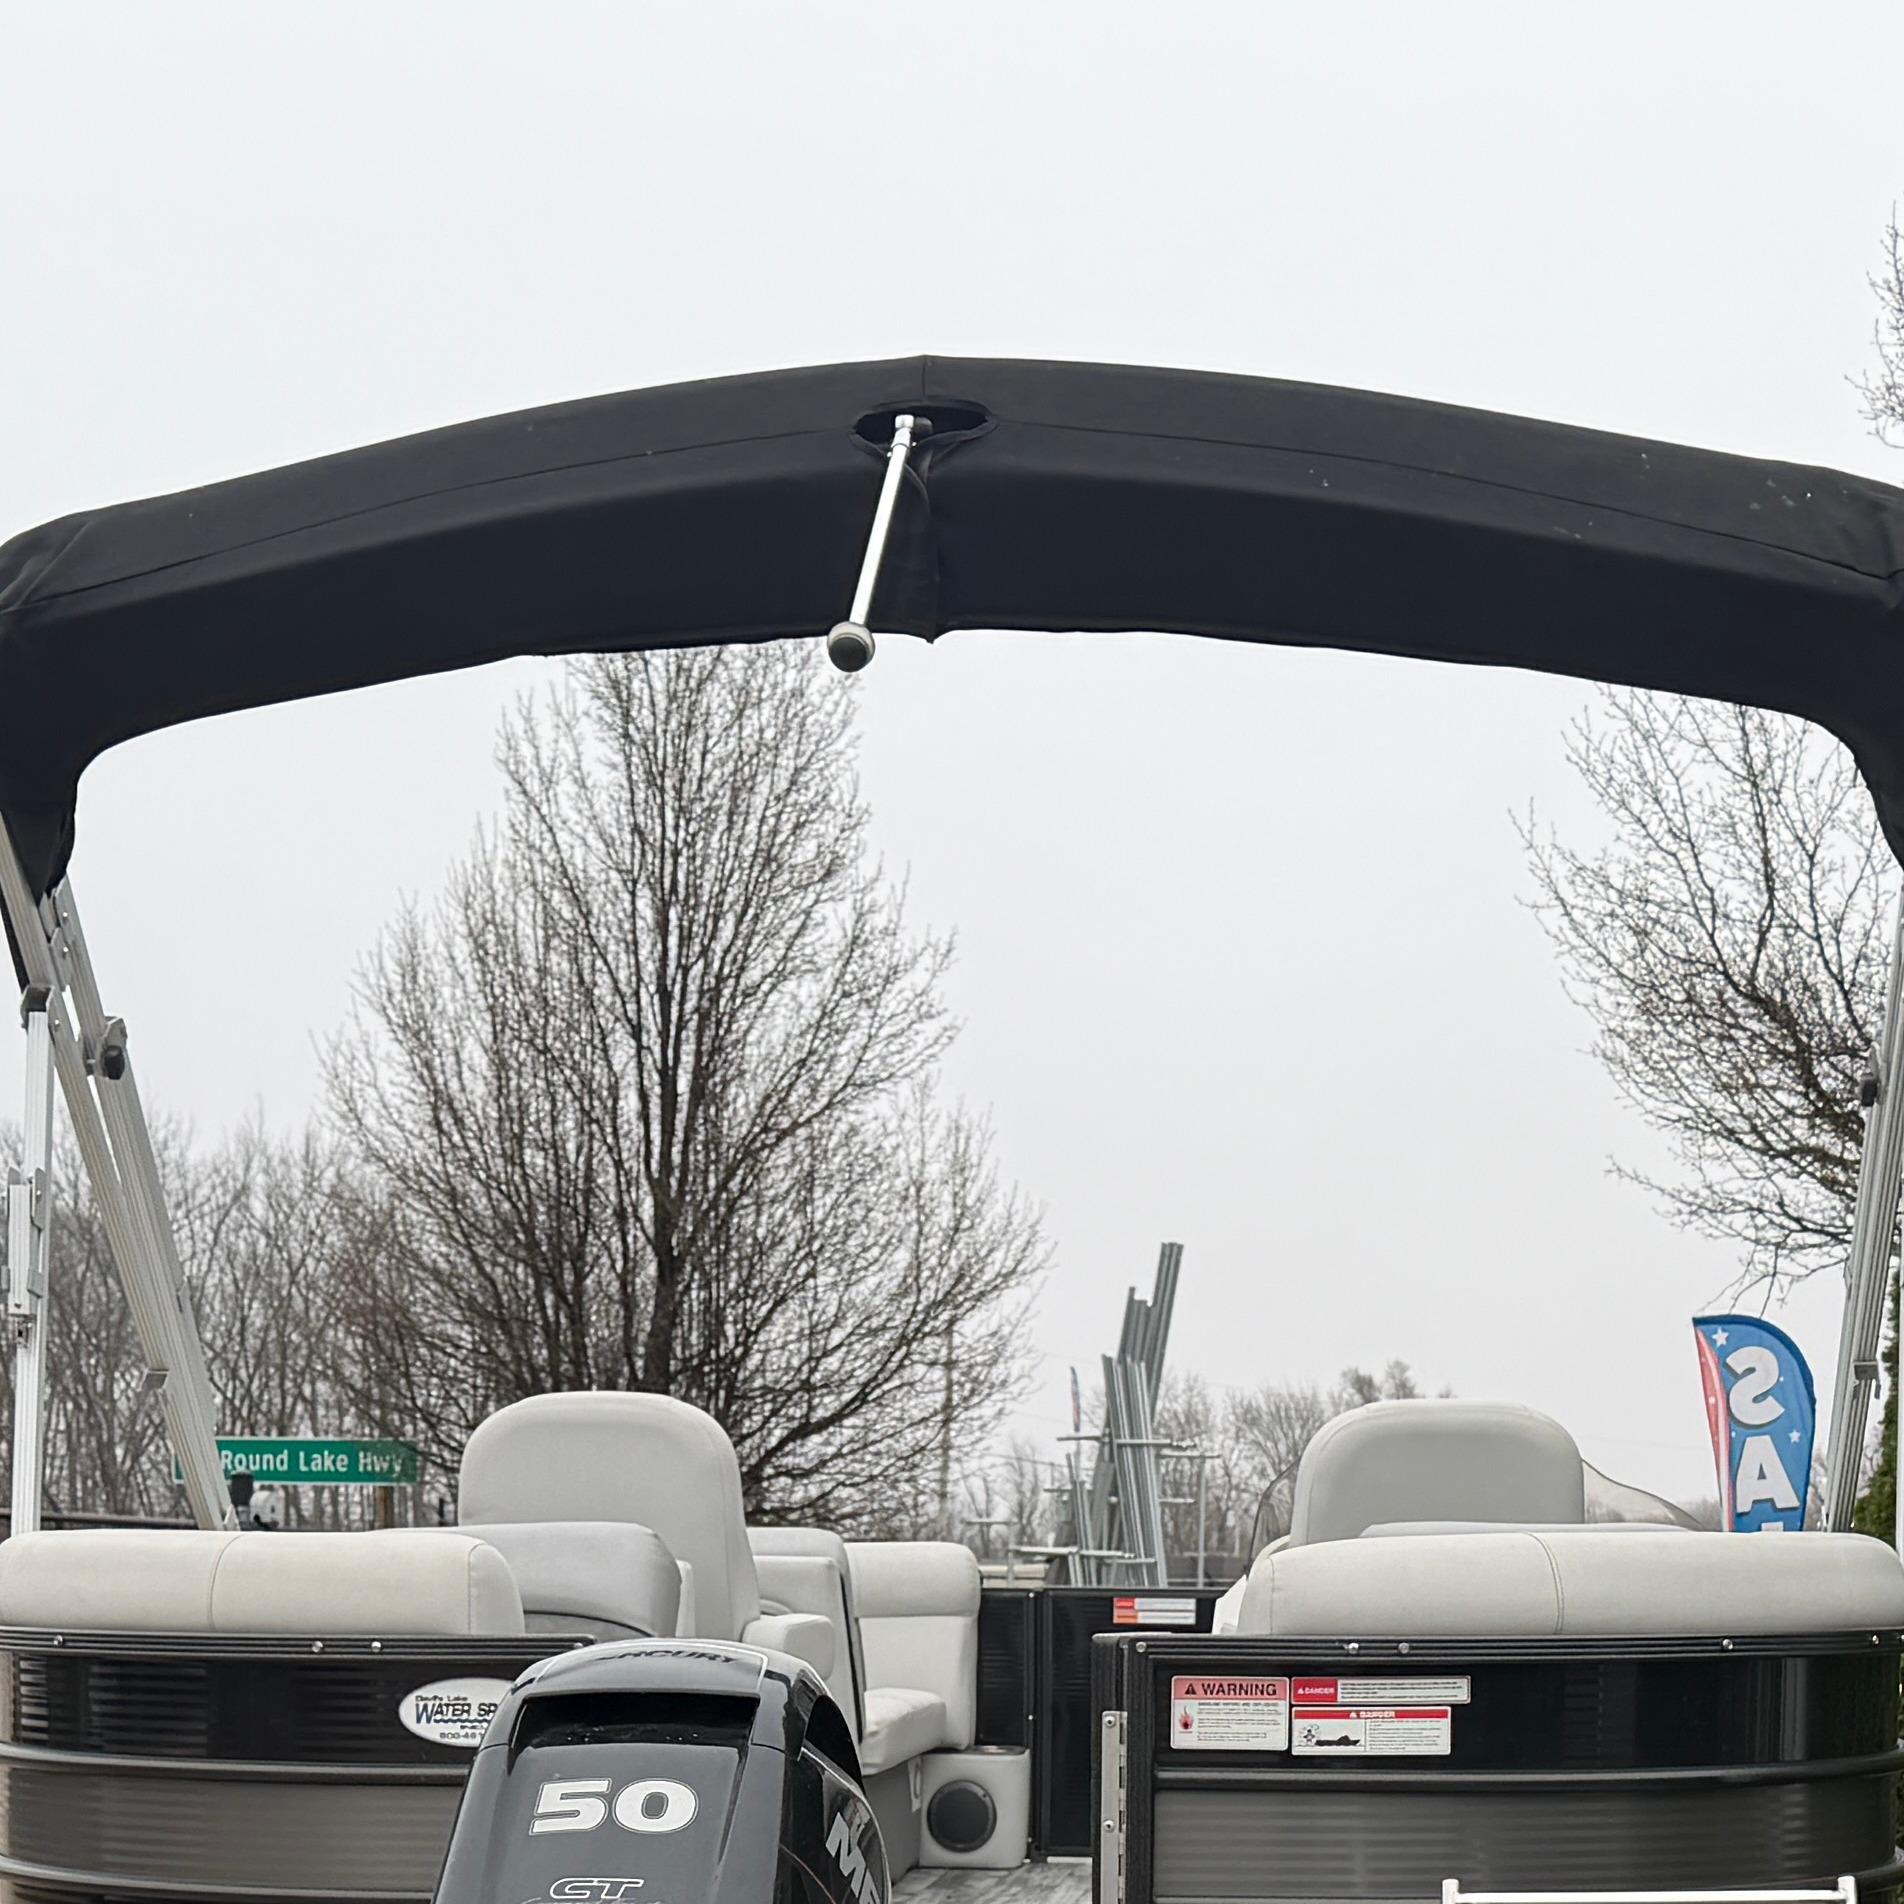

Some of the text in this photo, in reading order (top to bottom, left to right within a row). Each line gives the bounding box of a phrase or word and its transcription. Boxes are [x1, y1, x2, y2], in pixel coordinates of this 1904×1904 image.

[220, 1449, 403, 1477] Round Lake Hwy
[1201, 1683, 1278, 1697] WARNING
[415, 1703, 472, 1724] WATER
[529, 1778, 700, 1836] 50
